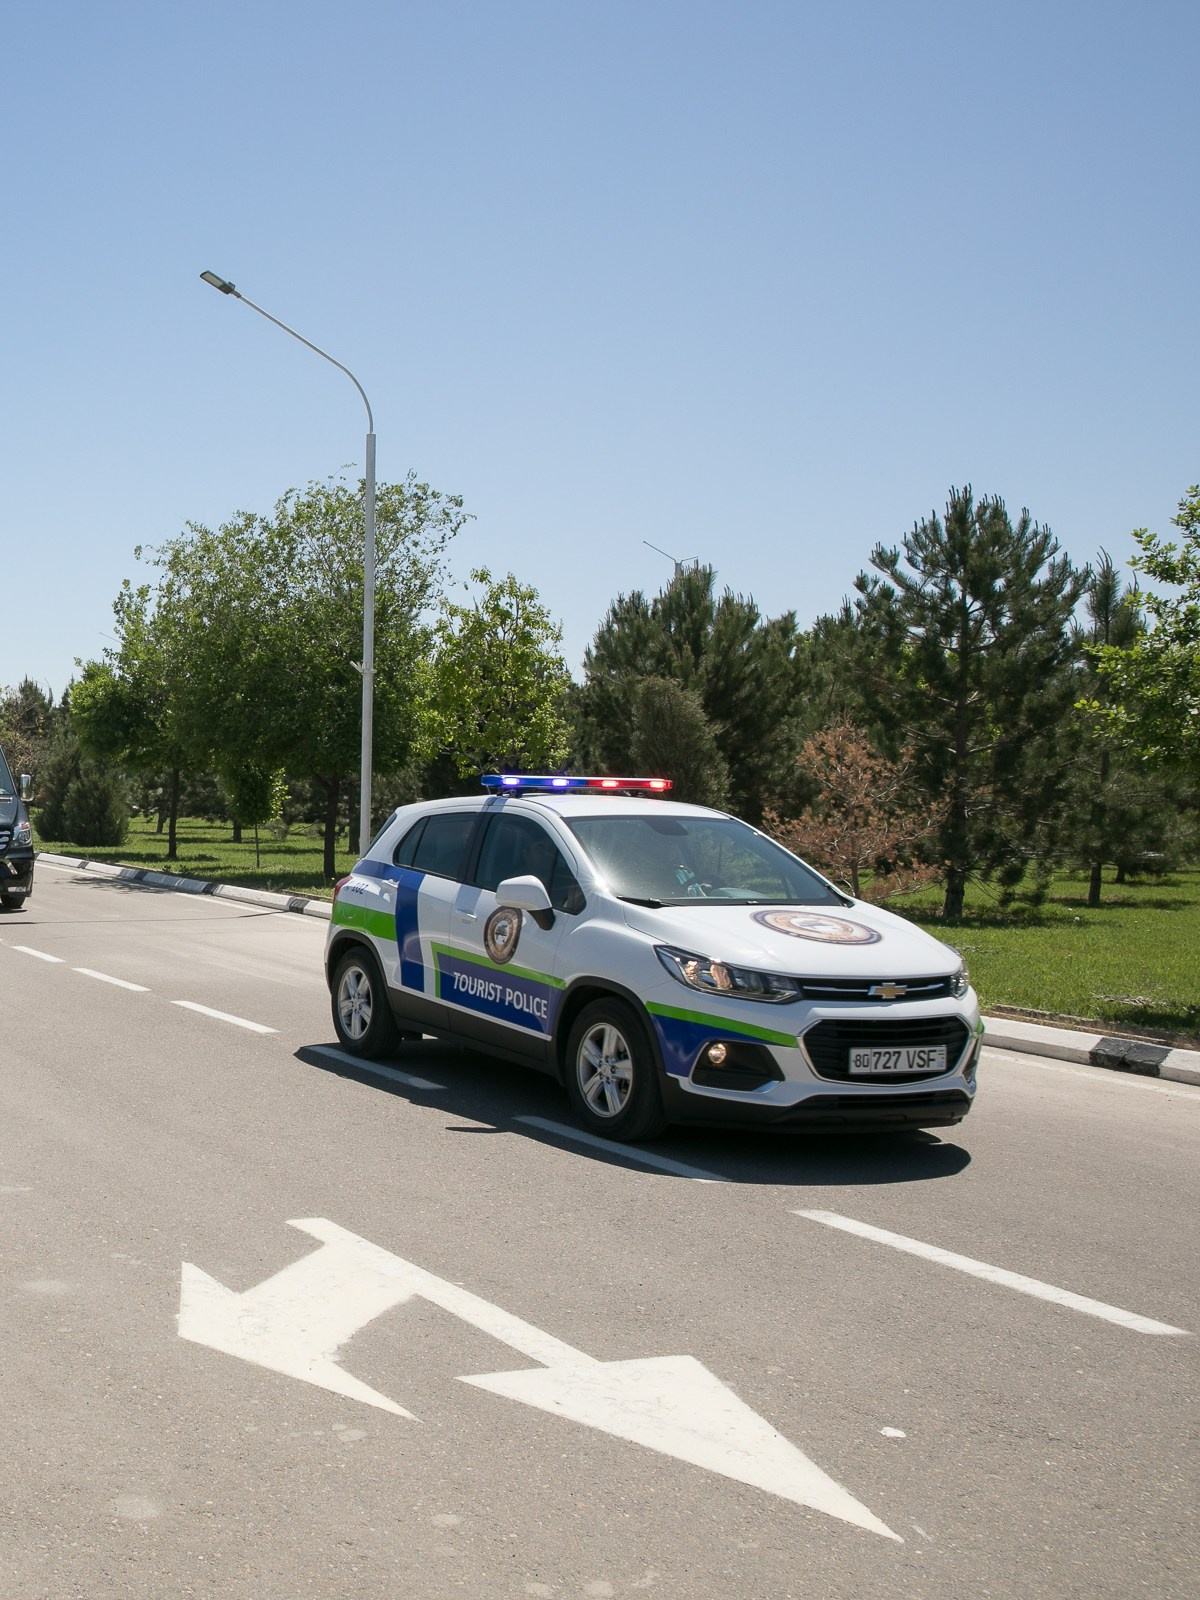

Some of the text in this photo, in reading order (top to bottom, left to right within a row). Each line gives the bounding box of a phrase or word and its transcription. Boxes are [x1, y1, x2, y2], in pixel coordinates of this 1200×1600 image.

[453, 971, 548, 1019] TOURIST POLICE
[854, 1049, 937, 1070] 80 727 VSF
